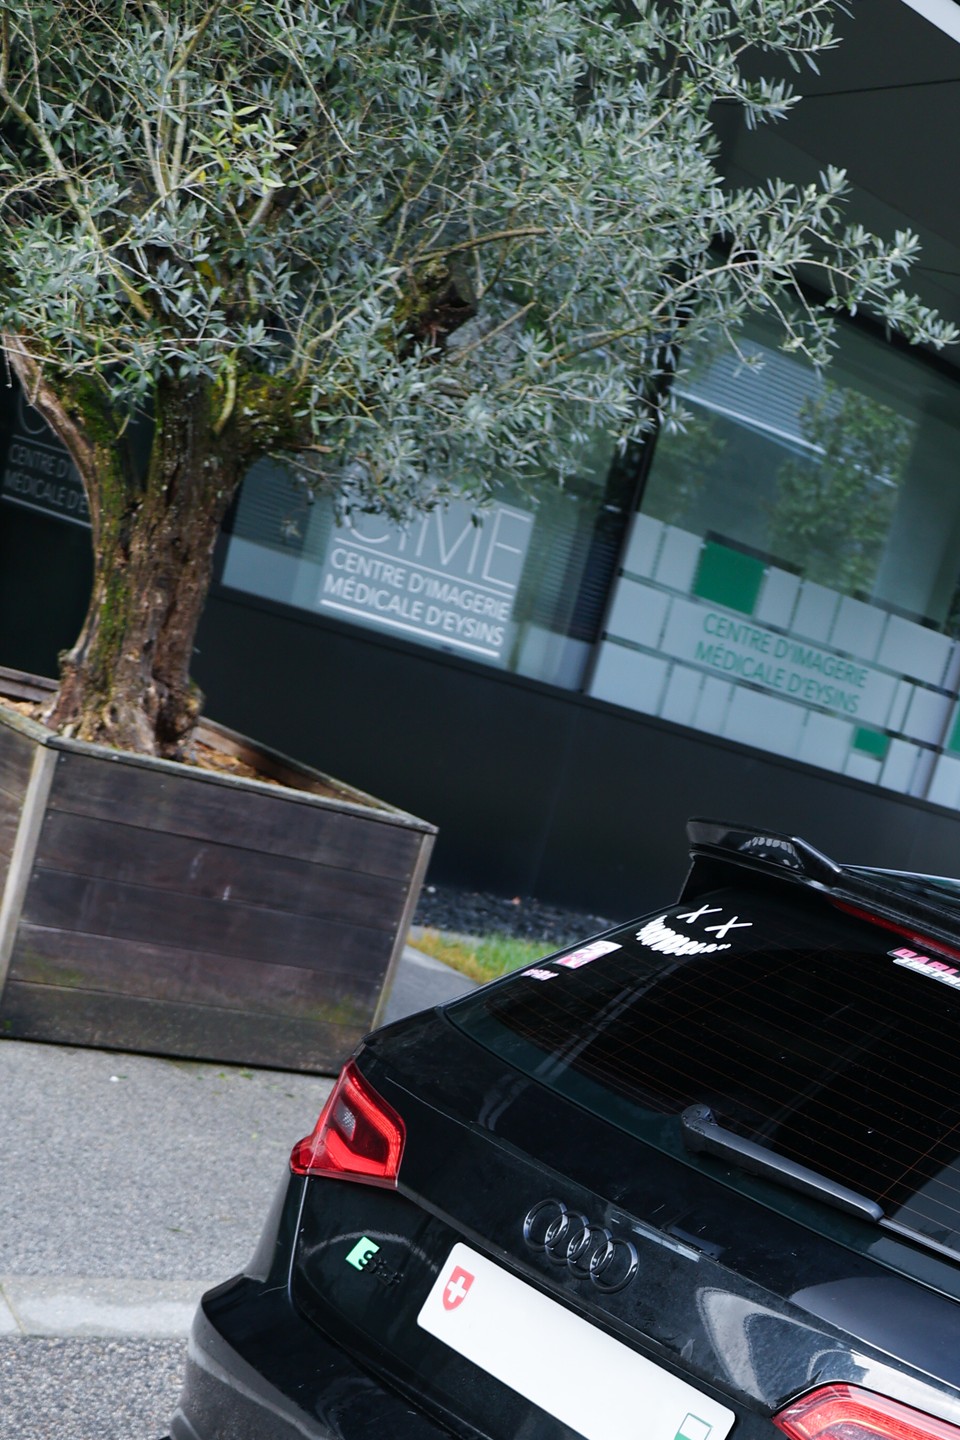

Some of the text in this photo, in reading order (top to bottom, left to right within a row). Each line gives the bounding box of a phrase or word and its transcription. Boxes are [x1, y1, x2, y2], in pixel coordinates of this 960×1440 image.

[324, 573, 505, 646] MÉDICALE D'EYSINS
[331, 548, 511, 622] CENTRE D'IMAGERIE
[694, 640, 860, 714] MÉDICALE D'EYSINS
[703, 612, 869, 689] CENTRE D'IMAGERIE
